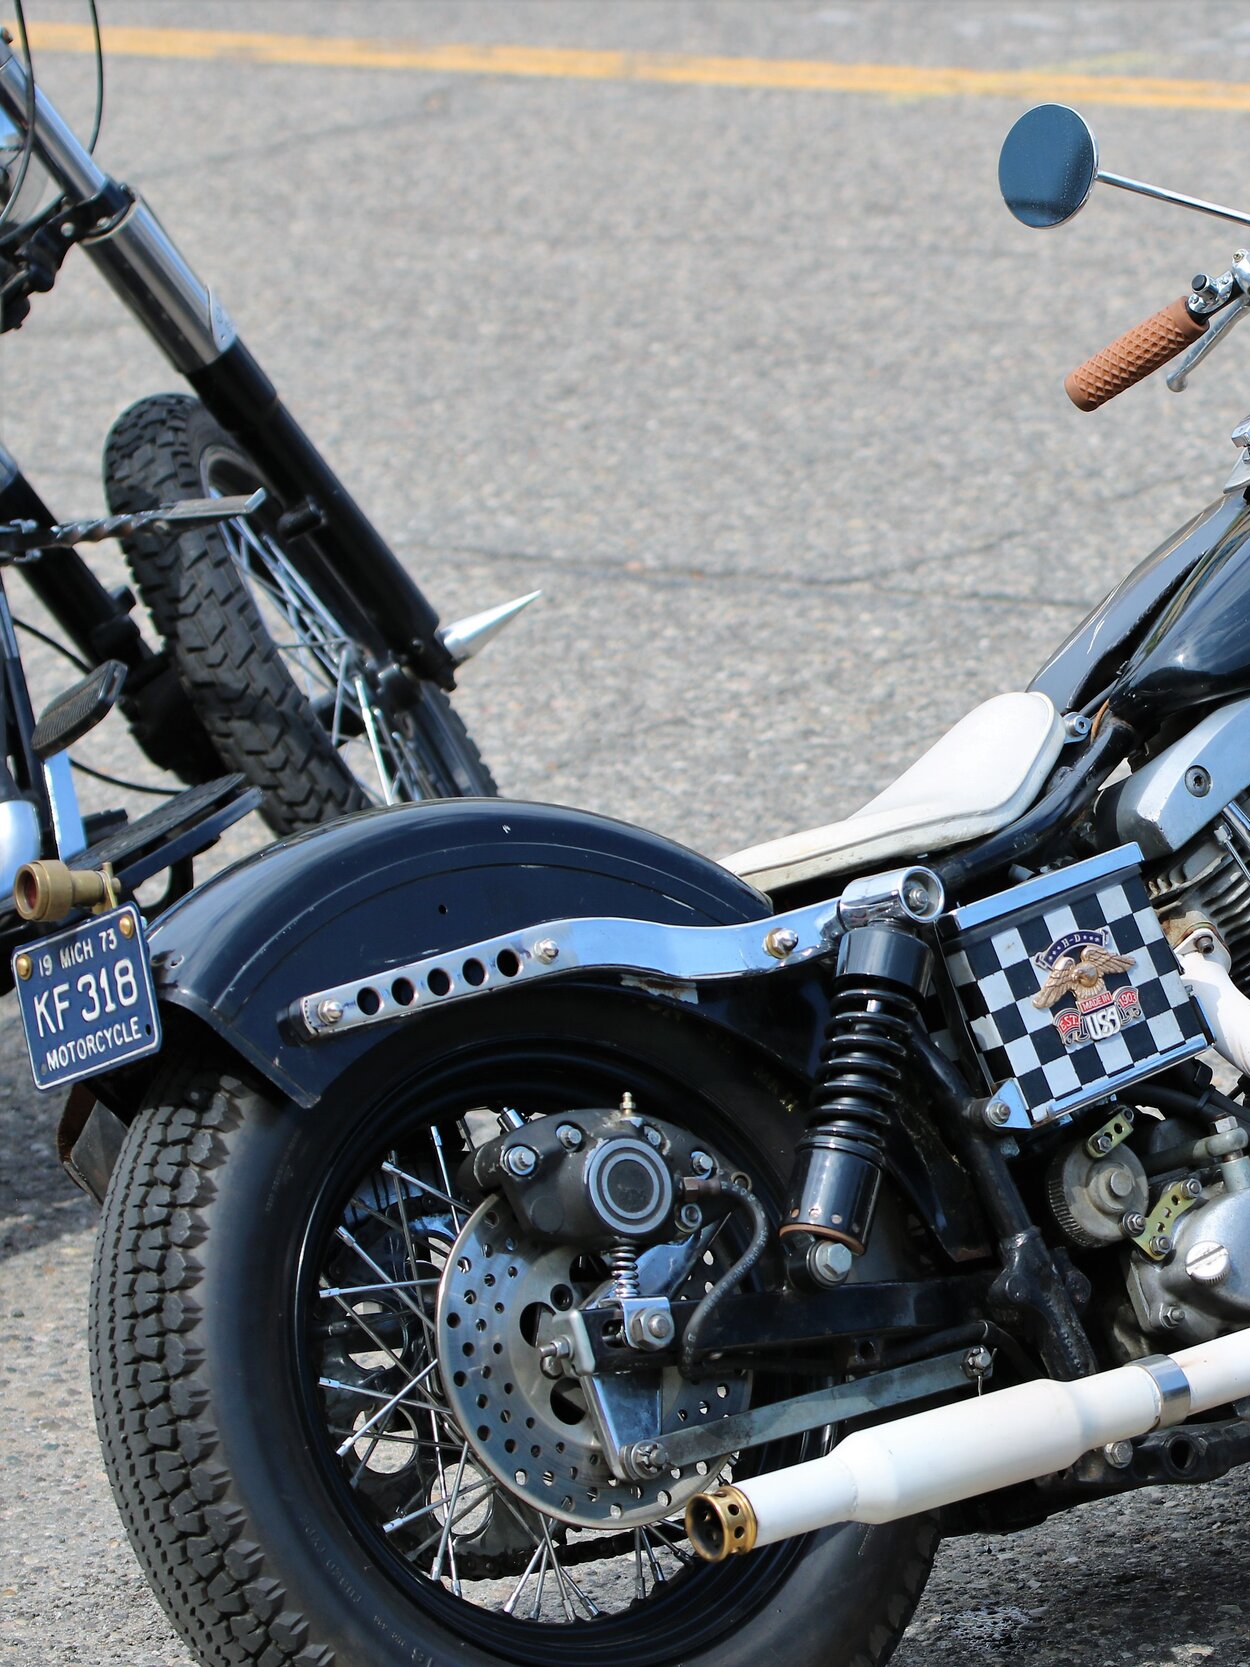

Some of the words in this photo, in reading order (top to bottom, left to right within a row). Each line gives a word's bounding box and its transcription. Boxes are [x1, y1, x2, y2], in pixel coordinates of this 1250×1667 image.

[39, 954, 53, 977] 19
[59, 938, 94, 969] MICH
[99, 928, 117, 952] 73
[1082, 996, 1101, 1010] MADE
[1101, 993, 1112, 1004] IN
[1119, 992, 1137, 1007] 1903
[1086, 1007, 1121, 1039] USA
[46, 1016, 142, 1071] MOTORCYCLE
